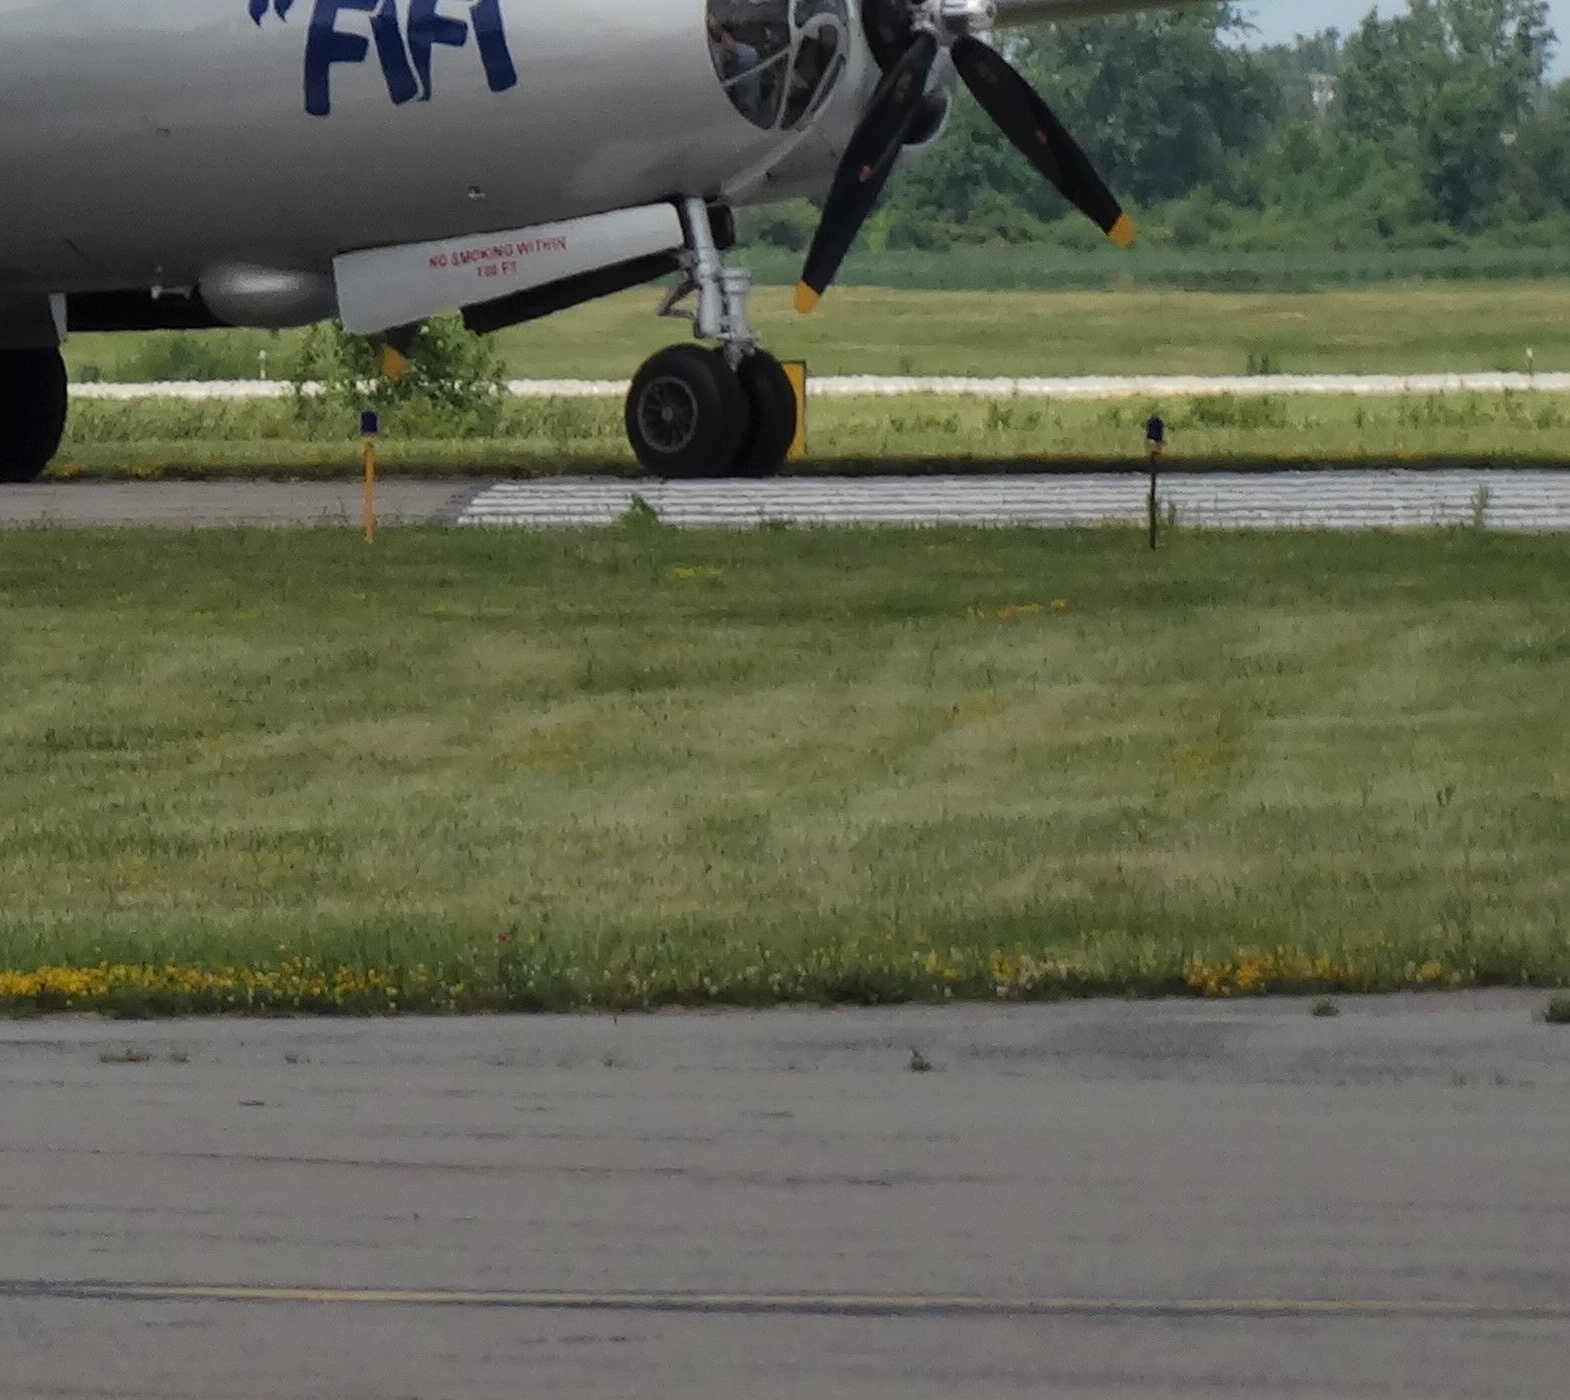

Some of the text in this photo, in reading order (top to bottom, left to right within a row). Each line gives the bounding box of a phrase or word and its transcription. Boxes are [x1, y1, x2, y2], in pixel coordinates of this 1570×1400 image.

[428, 236, 568, 268] NO SMOKING WITHIN
[501, 260, 517, 275] FT
